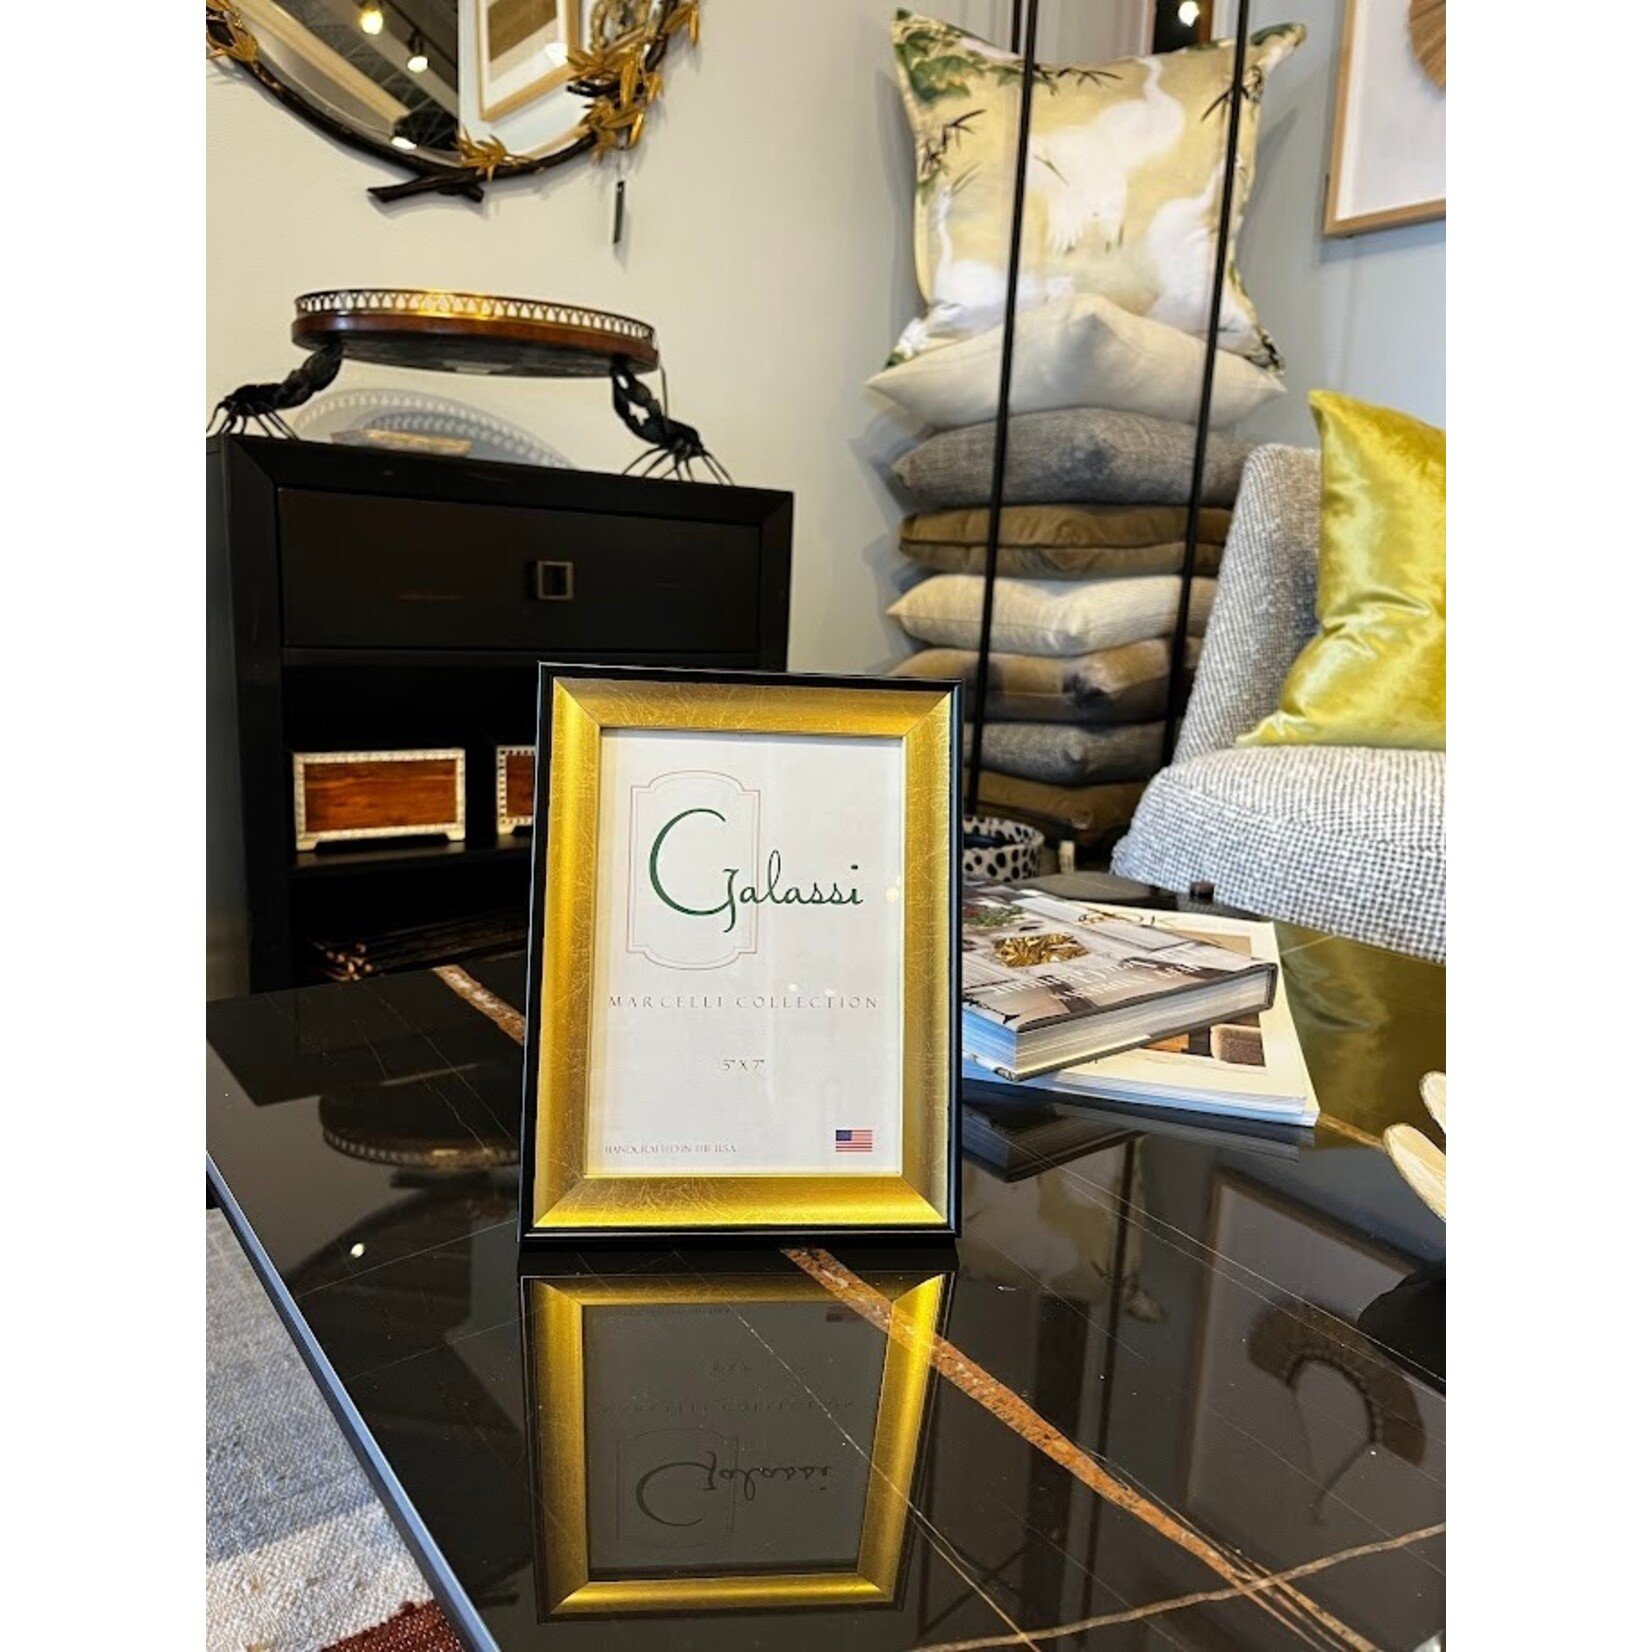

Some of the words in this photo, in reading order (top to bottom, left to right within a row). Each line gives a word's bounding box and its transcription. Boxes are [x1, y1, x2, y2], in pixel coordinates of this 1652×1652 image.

[648, 808, 863, 933] Galassi
[608, 995, 722, 1009] MARCELLI
[736, 995, 878, 1009] COLLECTION
